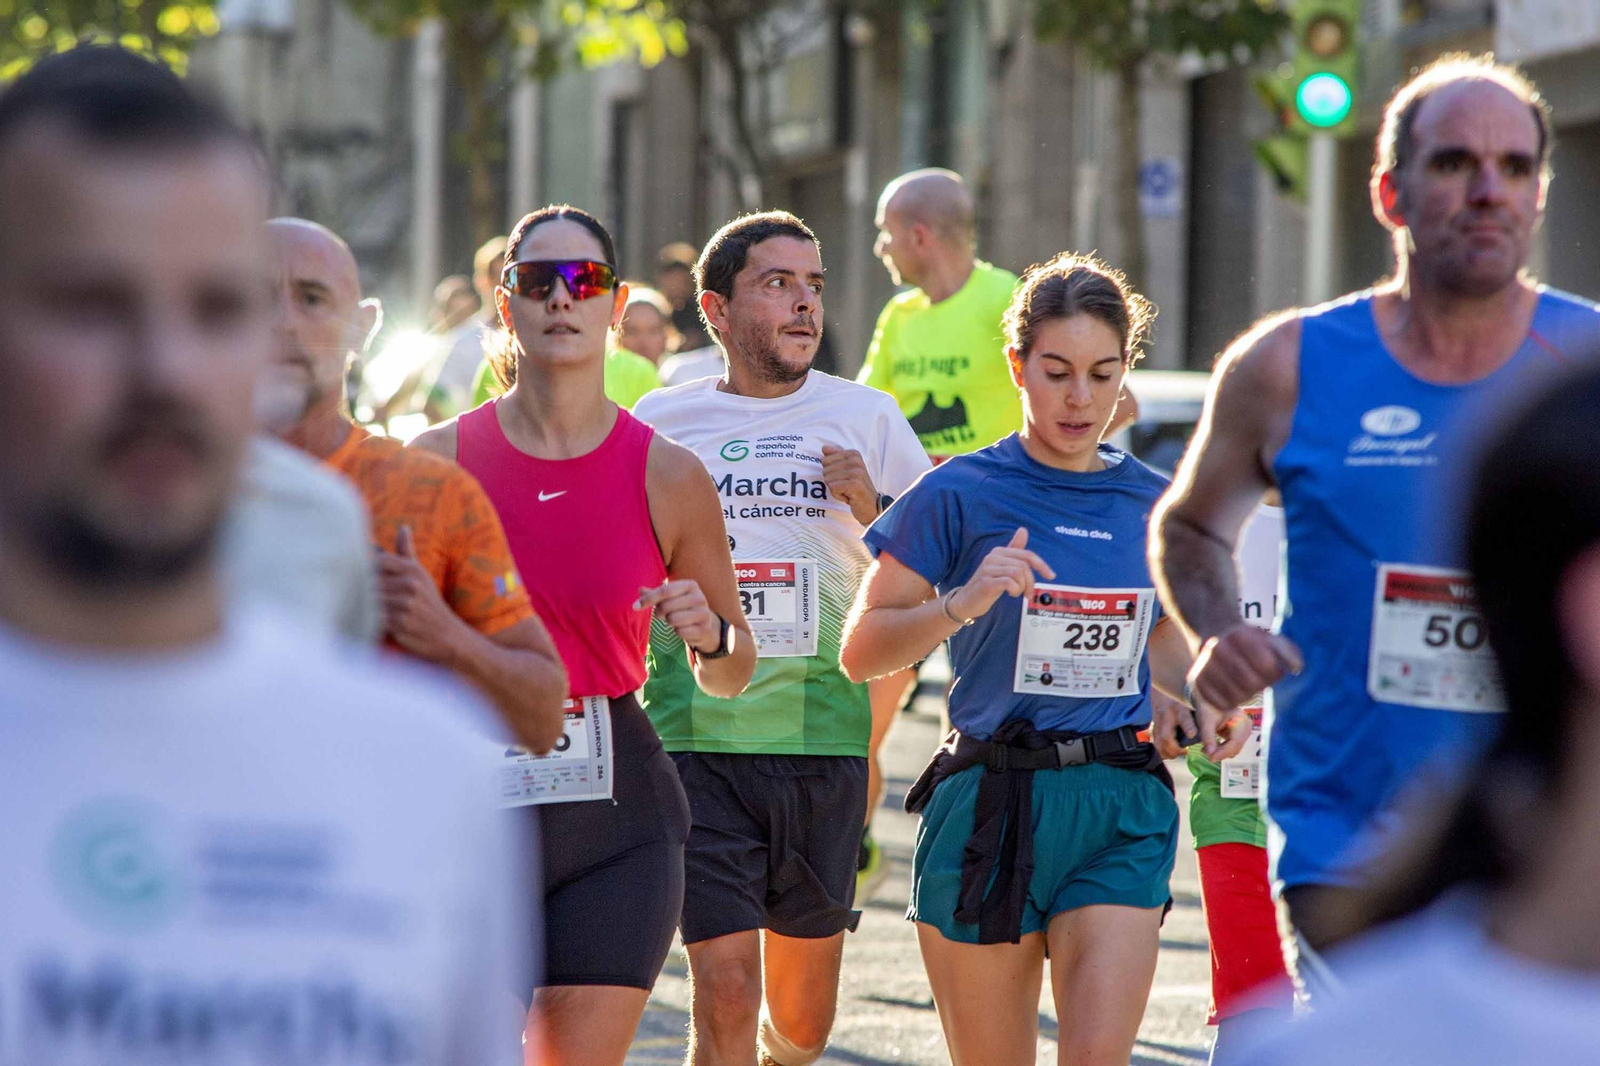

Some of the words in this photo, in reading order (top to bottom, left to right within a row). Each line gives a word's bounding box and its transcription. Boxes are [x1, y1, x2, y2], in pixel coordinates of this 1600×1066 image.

[756, 443, 796, 452] española
[755, 451, 784, 459] contra
[795, 453, 821, 463] cánce
[711, 472, 828, 500] Marcha
[740, 503, 802, 518] cáncer
[806, 509, 826, 518] en
[1055, 526, 1089, 537] shaka
[1090, 530, 1113, 540] club
[739, 590, 765, 616] 31
[1039, 610, 1054, 618] Vigo
[803, 631, 809, 639] 31
[1063, 623, 1120, 651] 238
[590, 697, 602, 758] GUARDARROPA
